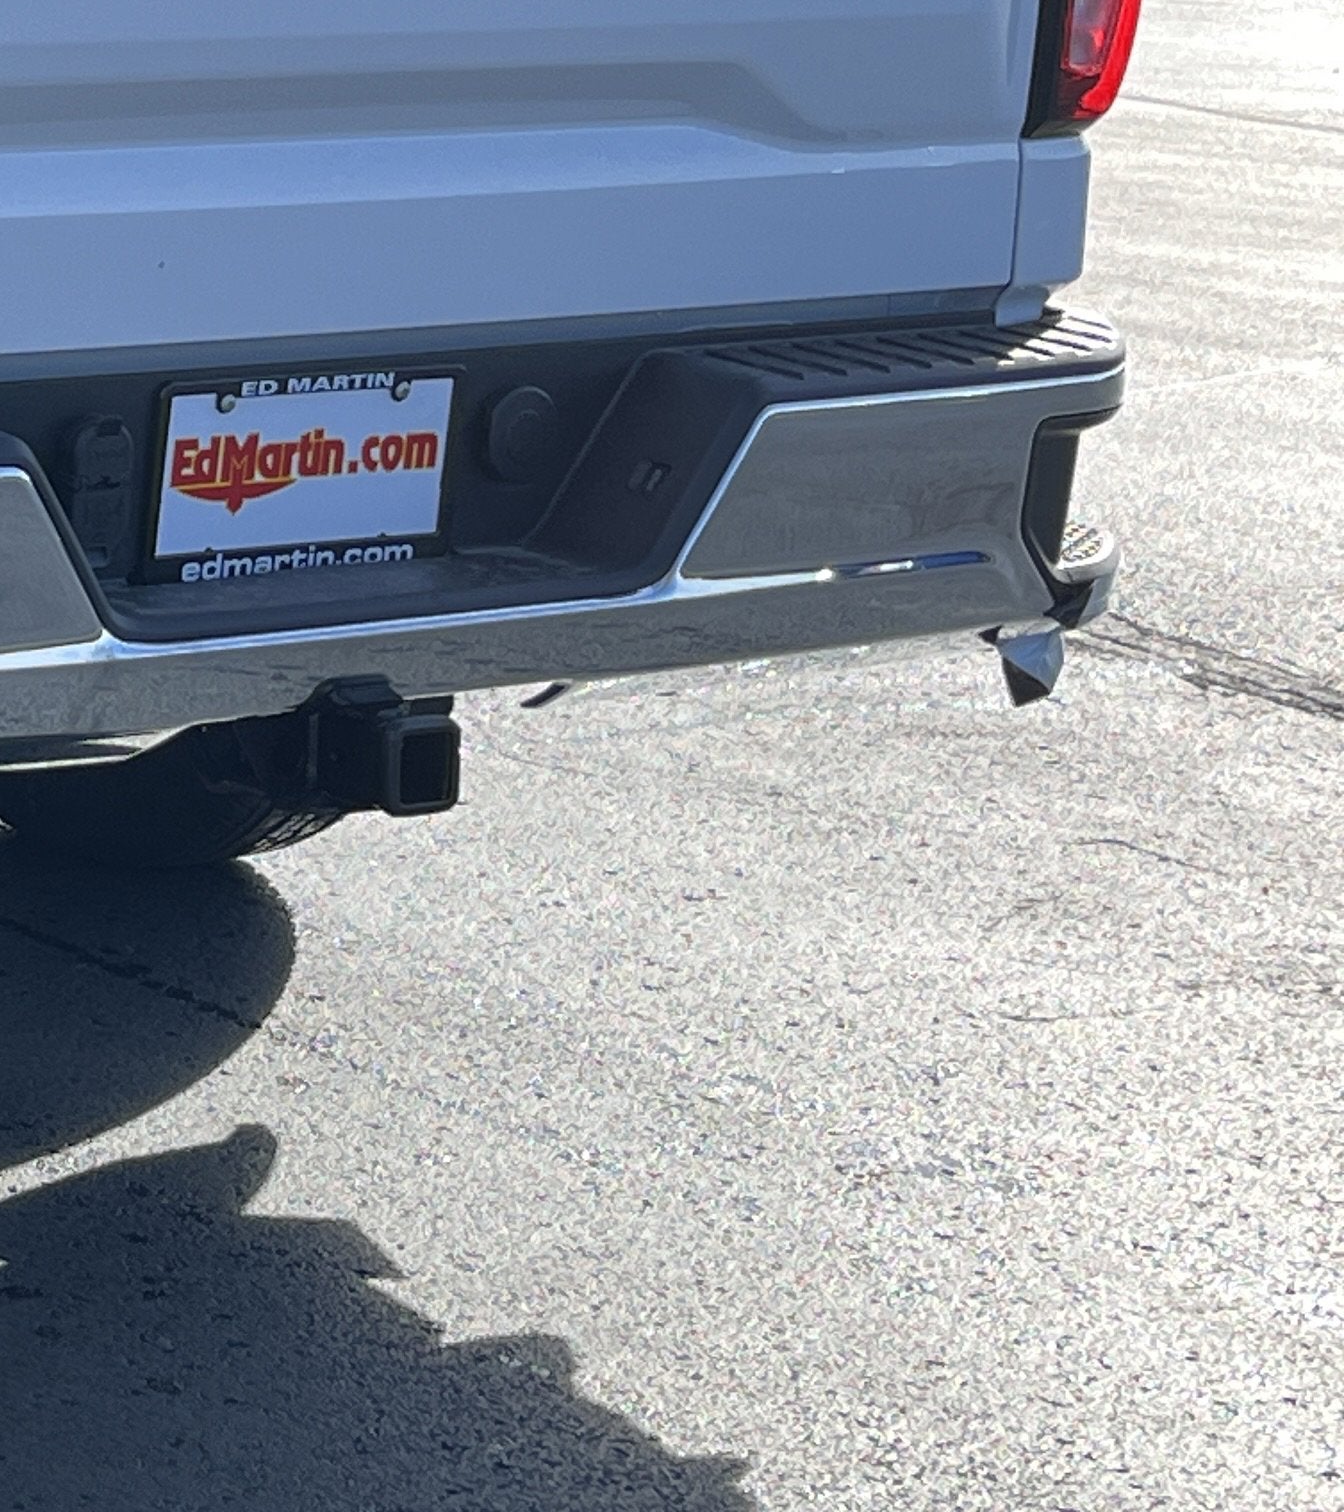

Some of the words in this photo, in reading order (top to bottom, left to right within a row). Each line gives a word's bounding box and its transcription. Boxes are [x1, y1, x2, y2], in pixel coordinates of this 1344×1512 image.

[240, 380, 279, 398] ED
[287, 371, 397, 394] MARTIN
[171, 428, 438, 488] EdMartin.com
[181, 544, 414, 583] edmartin.com
